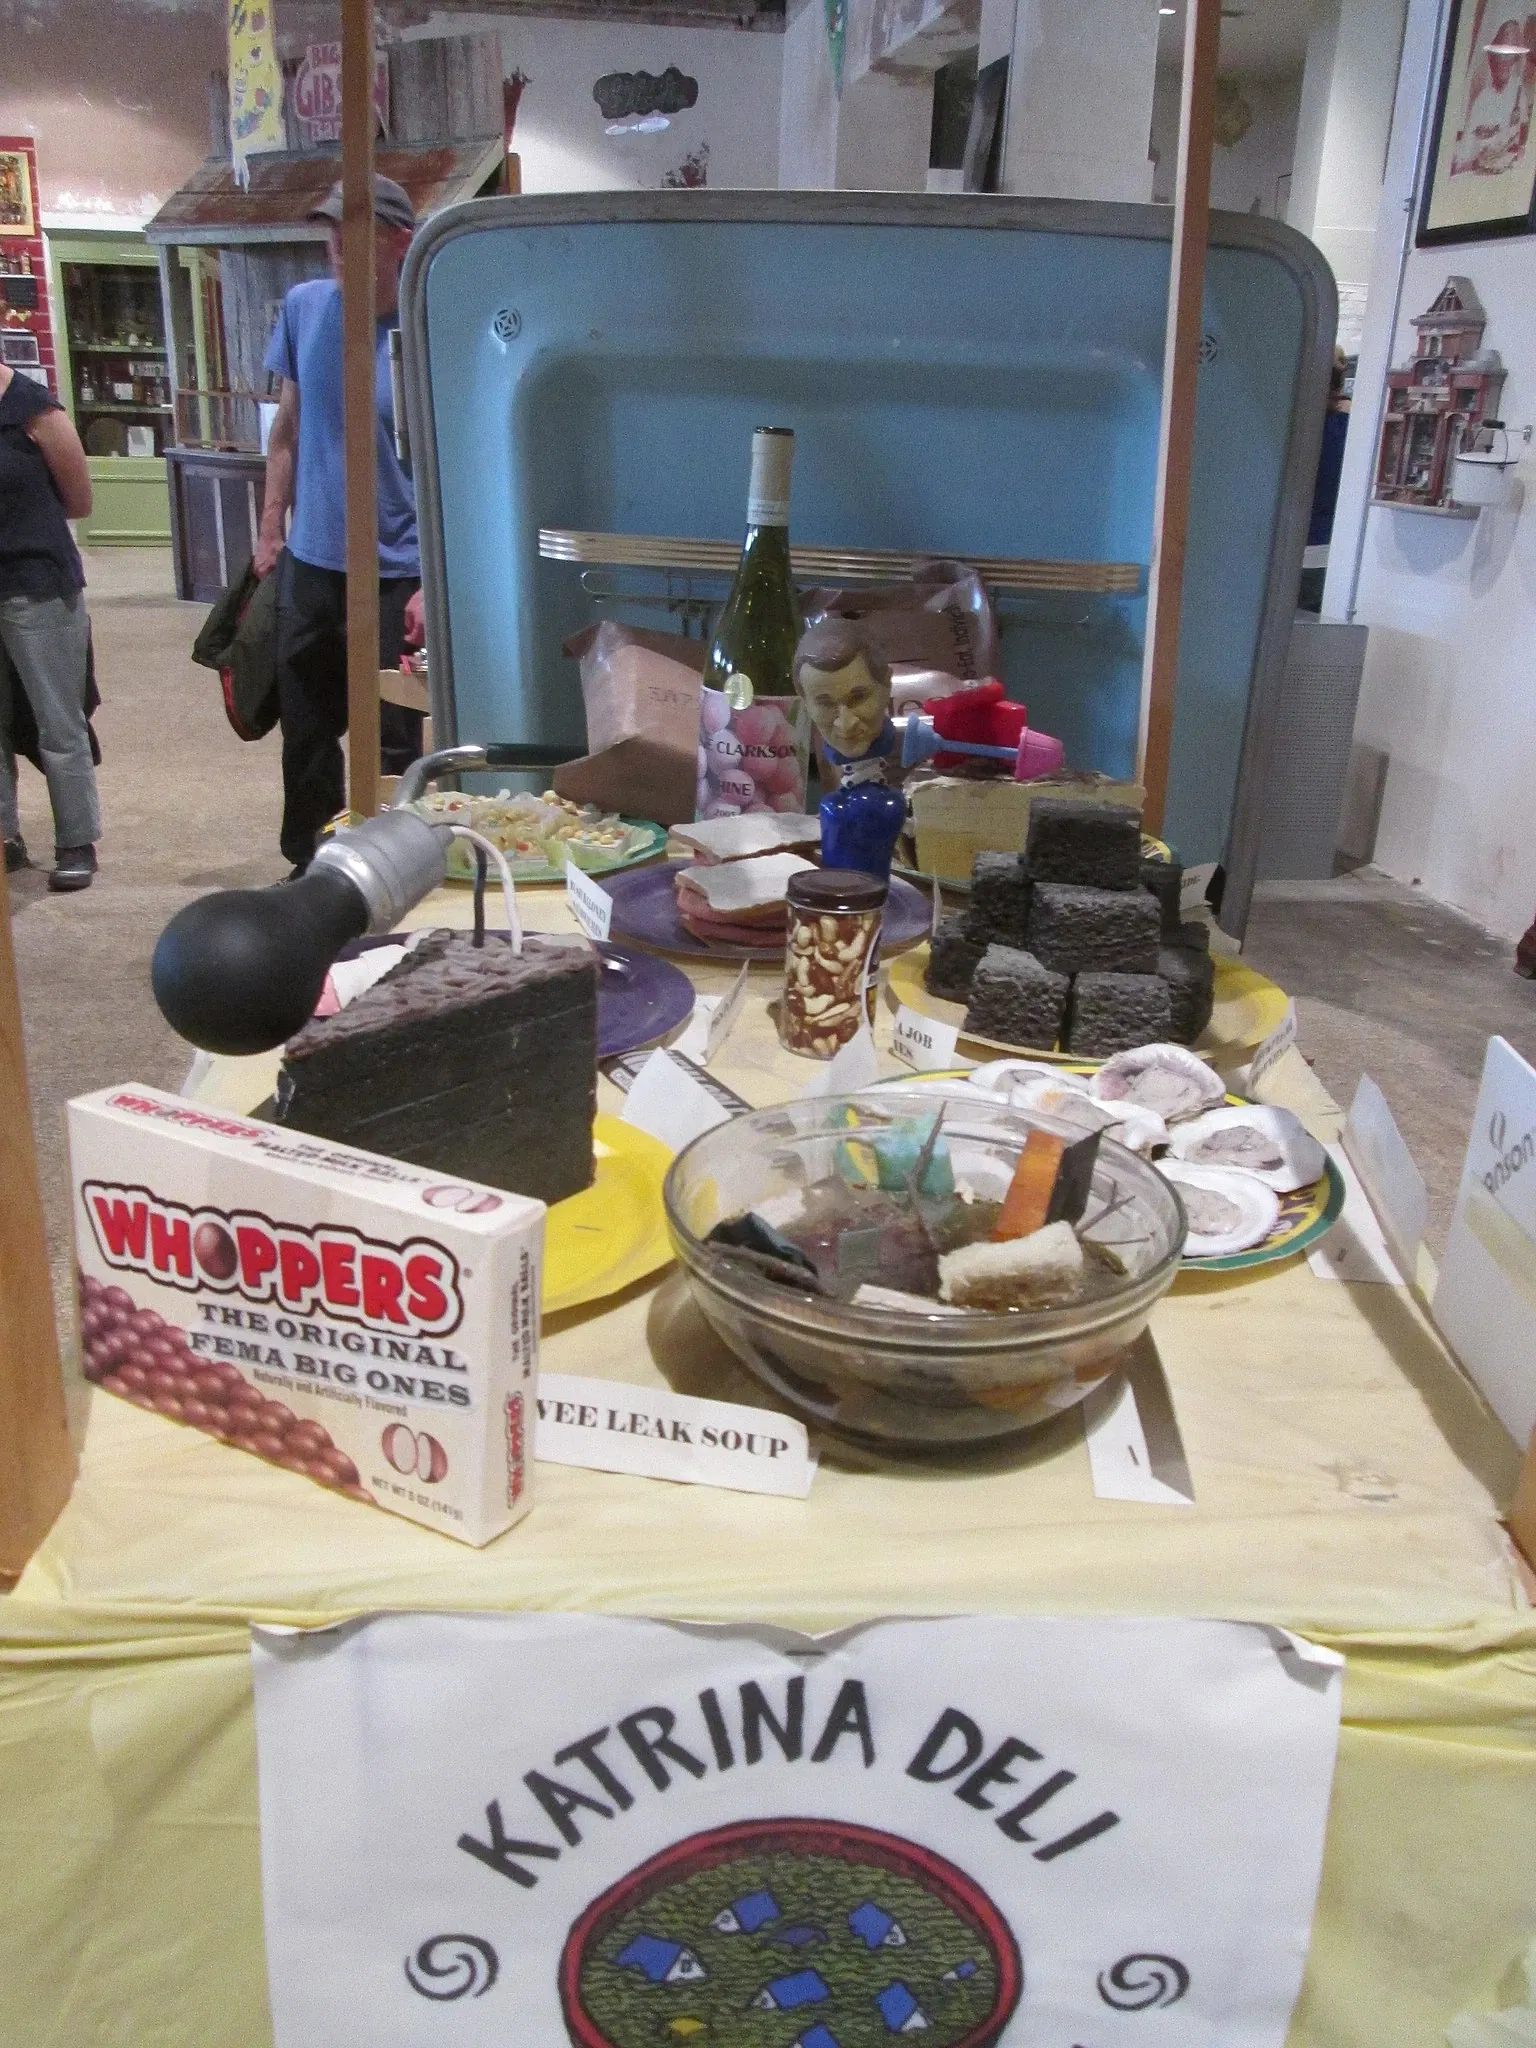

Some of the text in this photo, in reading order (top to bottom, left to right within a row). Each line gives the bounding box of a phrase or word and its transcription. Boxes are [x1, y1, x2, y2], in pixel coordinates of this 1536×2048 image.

[716, 740, 798, 759] CLARKSON
[906, 1027, 933, 1050] JOB
[93, 1196, 448, 1326] WHOPPERS
[189, 1331, 473, 1408] FEMA BIG ONES
[197, 1303, 269, 1333] THE
[274, 1317, 468, 1372] ORIGINAL
[607, 1408, 694, 1445] LEAK
[700, 1425, 789, 1459] SOUP
[456, 1674, 1122, 1890] KATRINA DELI
